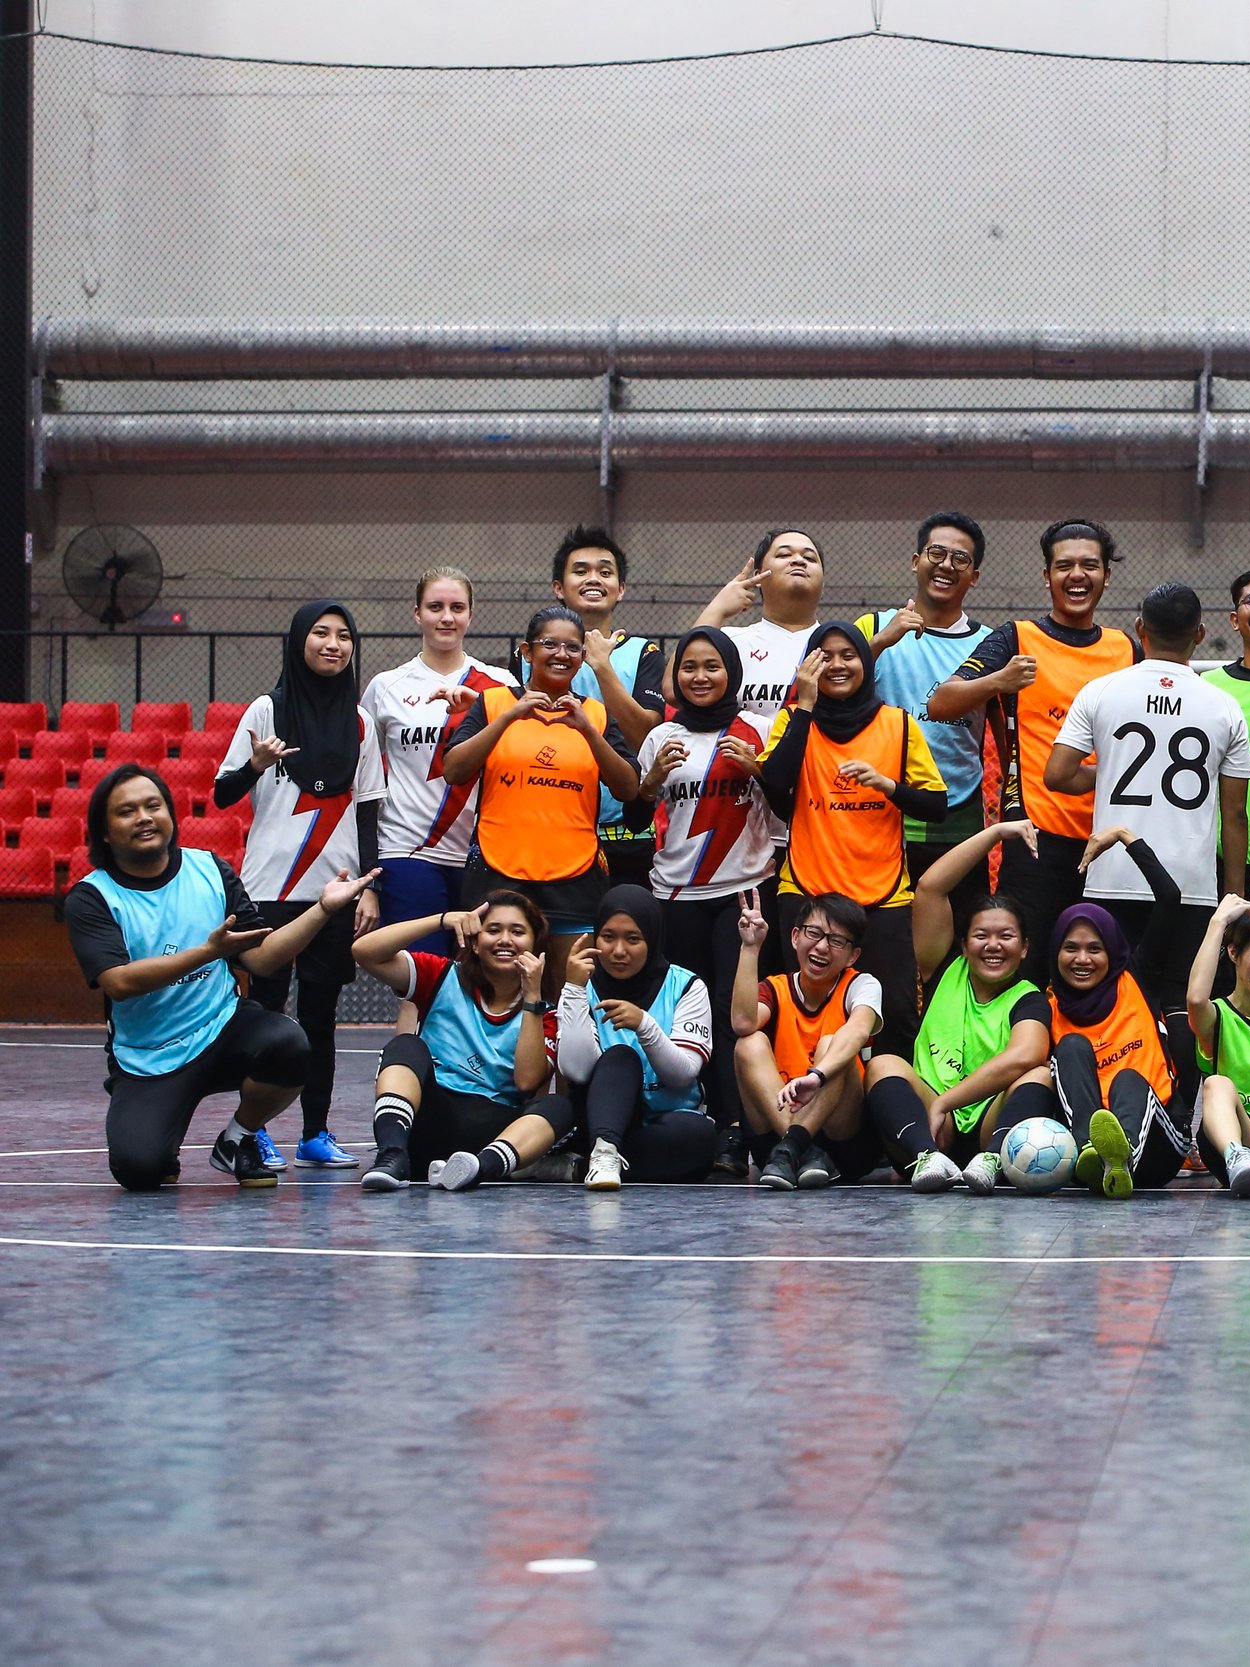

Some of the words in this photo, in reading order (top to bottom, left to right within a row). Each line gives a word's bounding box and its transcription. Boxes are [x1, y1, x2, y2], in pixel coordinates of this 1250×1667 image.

[1146, 694, 1182, 716] KIM
[1109, 721, 1211, 811] 28
[527, 776, 584, 793] KAKIJERSI
[829, 801, 886, 811] KAKIJERSI
[683, 1021, 709, 1039] QNB
